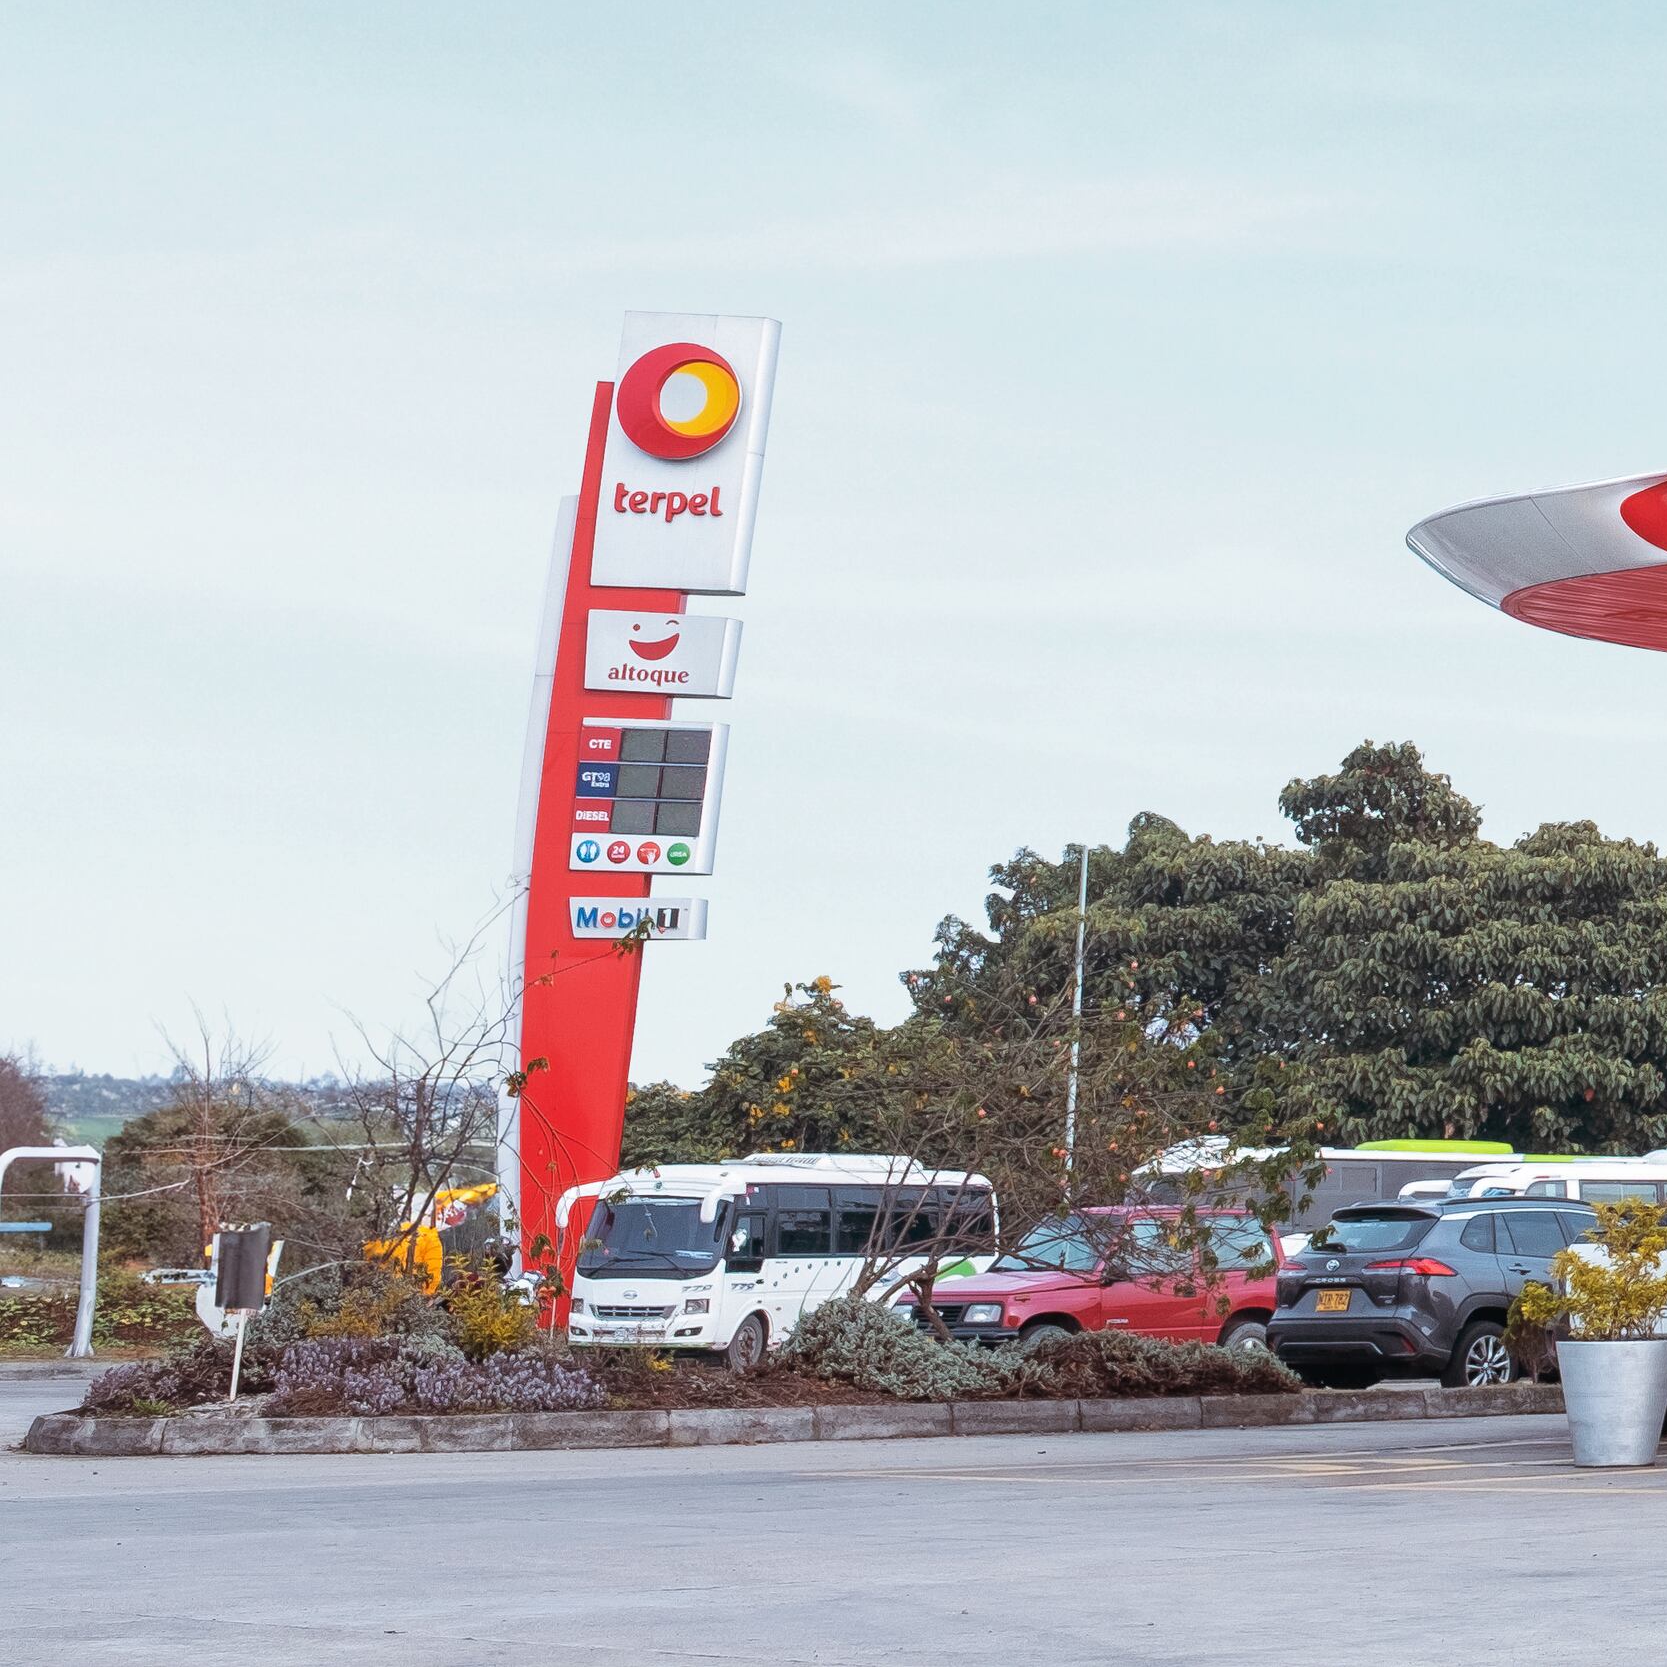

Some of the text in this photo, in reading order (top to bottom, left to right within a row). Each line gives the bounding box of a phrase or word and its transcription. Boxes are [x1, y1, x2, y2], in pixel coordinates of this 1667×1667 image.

[614, 482, 723, 523] terpel
[608, 663, 690, 686] altoque
[588, 738, 612, 750] CTE
[611, 845, 625, 854] 24
[576, 906, 650, 929] Mobil
